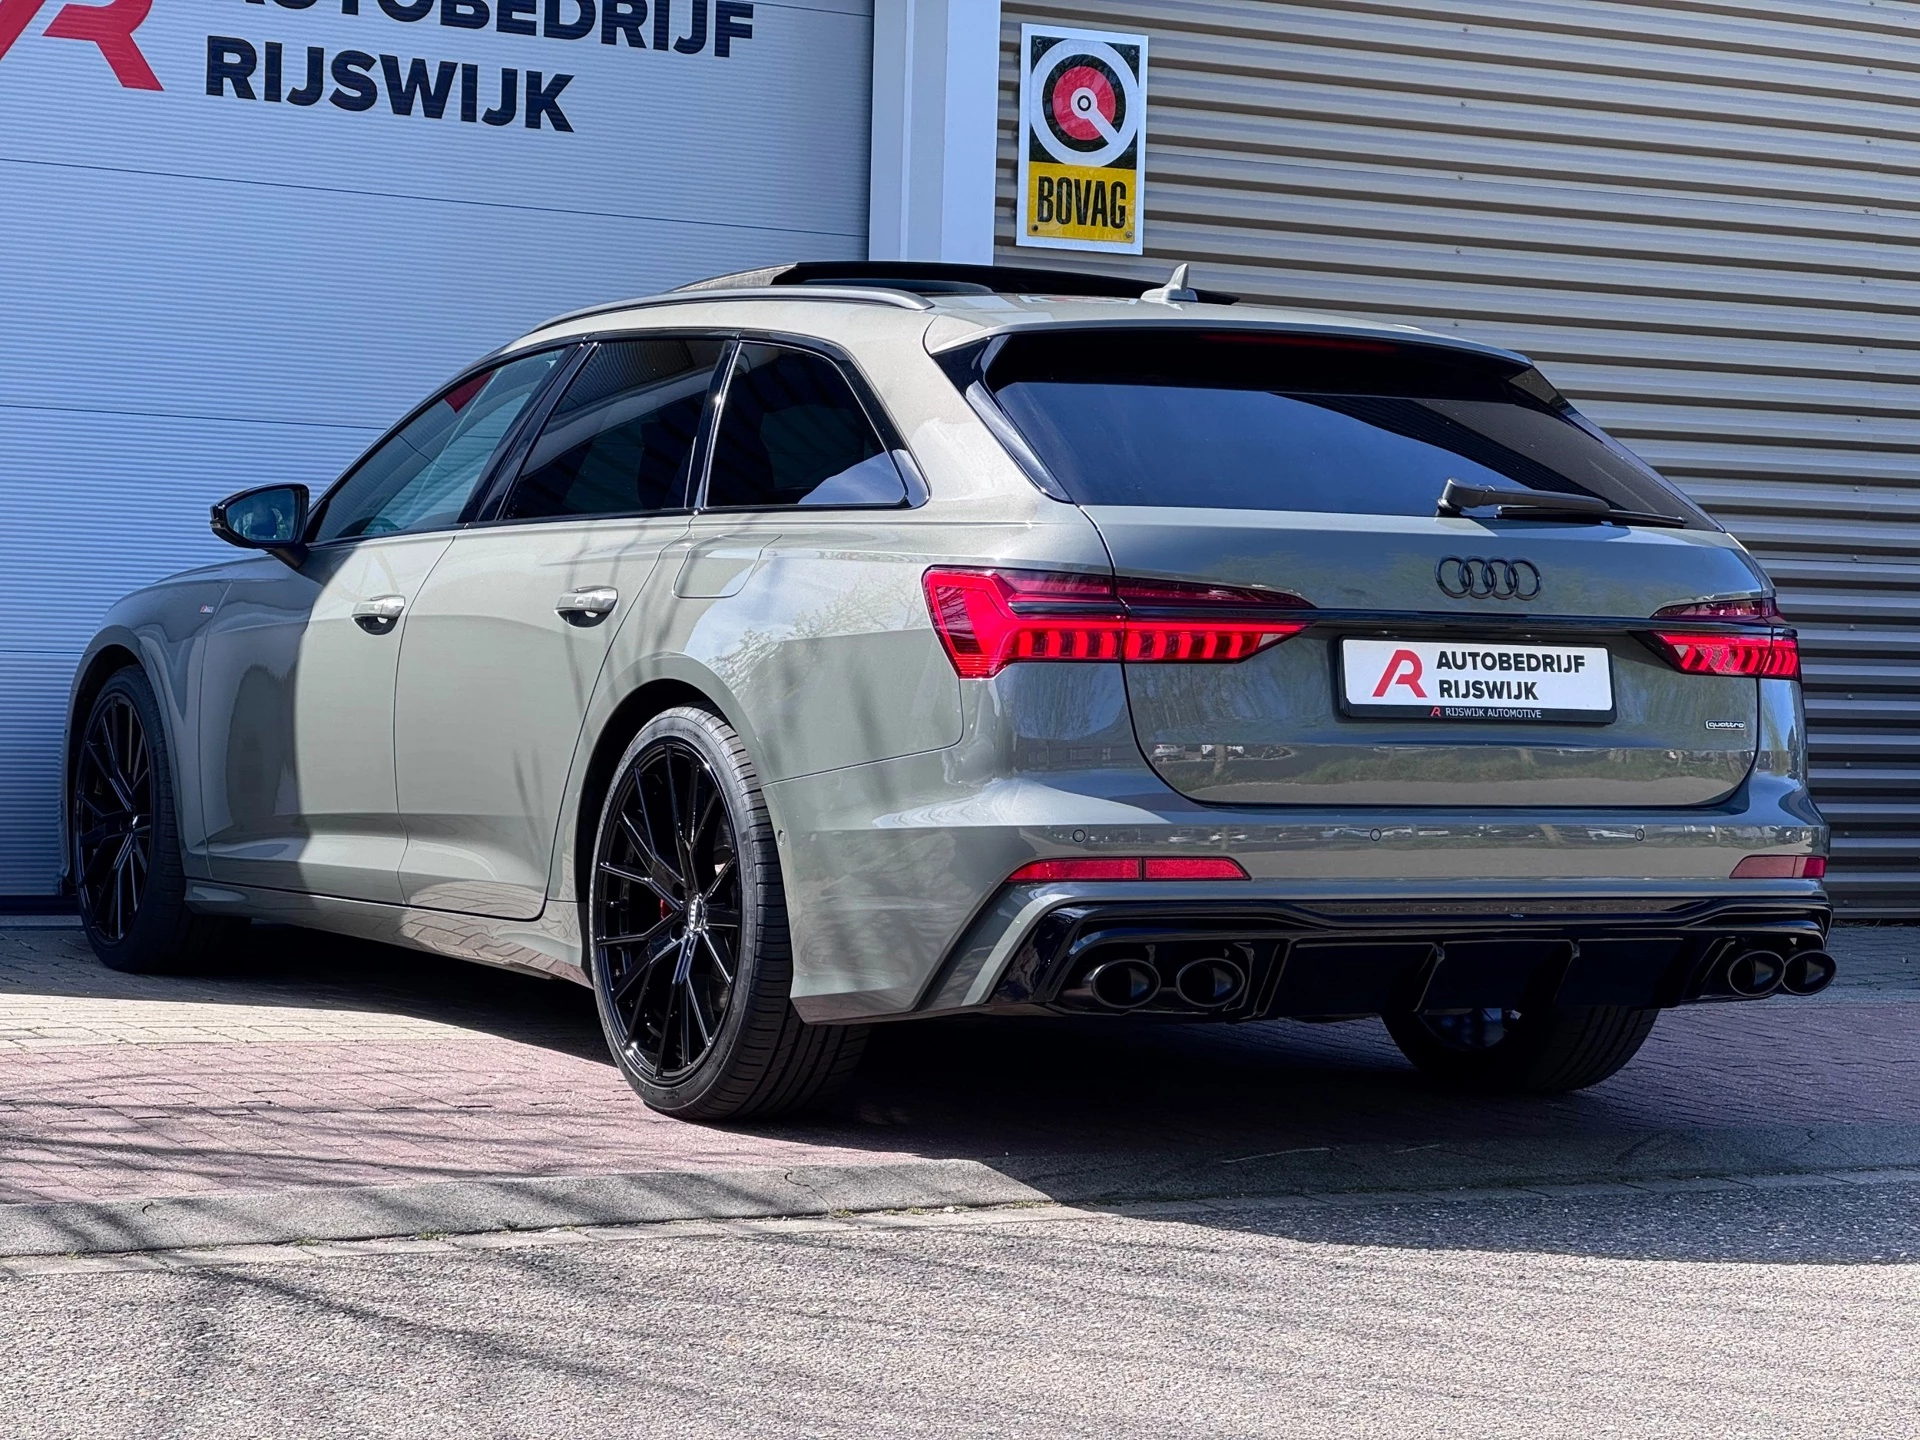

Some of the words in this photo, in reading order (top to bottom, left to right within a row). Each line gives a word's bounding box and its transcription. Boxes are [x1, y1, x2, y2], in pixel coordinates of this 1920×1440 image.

[245, 0, 754, 57] EDRIJF
[206, 35, 575, 132] RIJSWIJK
[1038, 176, 1126, 229] BOVAG
[1436, 651, 1585, 673] AUTOBEDRIJF
[1439, 680, 1539, 700] RIJSWIJK
[1446, 708, 1485, 717] RIJSWIJK
[1487, 708, 1542, 718] AUTOMOTIVE
[1708, 721, 1745, 729] quattro
